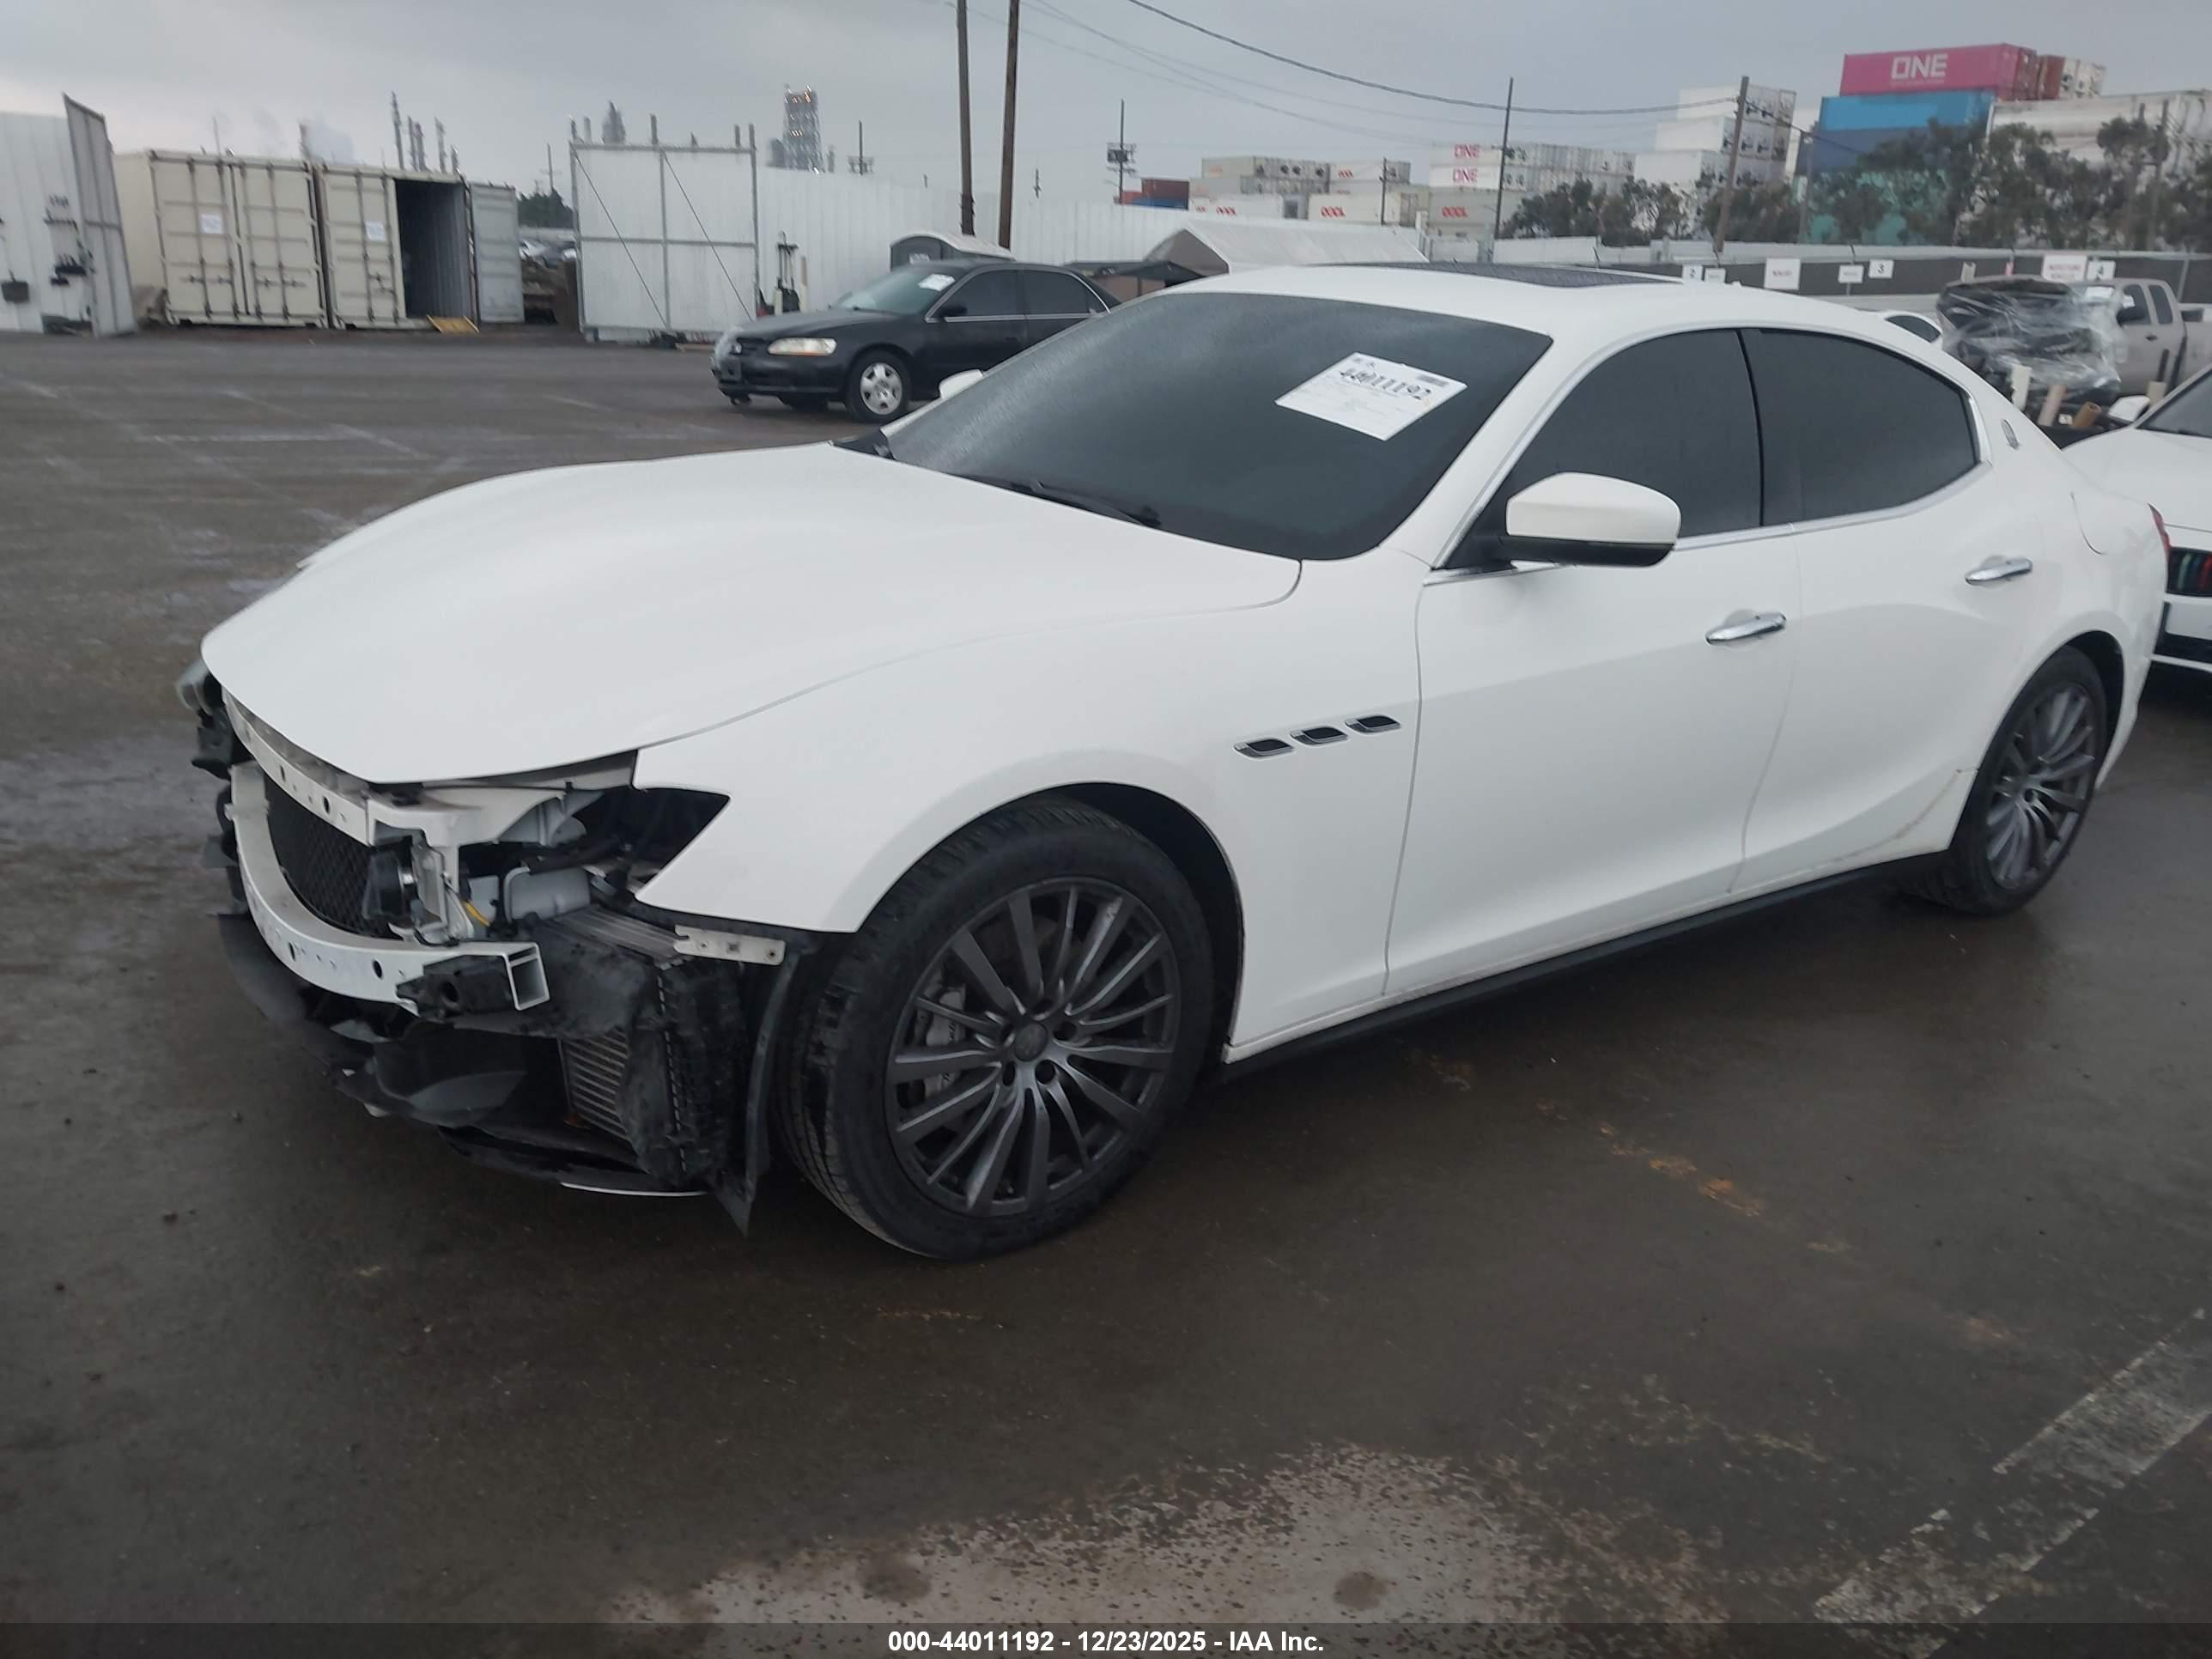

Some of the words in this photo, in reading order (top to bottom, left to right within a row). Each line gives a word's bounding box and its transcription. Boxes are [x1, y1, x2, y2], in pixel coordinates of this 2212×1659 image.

[1891, 53, 1948, 80] ONE
[1454, 144, 1480, 158] ONE
[1452, 167, 1478, 182] ONE
[1877, 263, 1886, 274] 3
